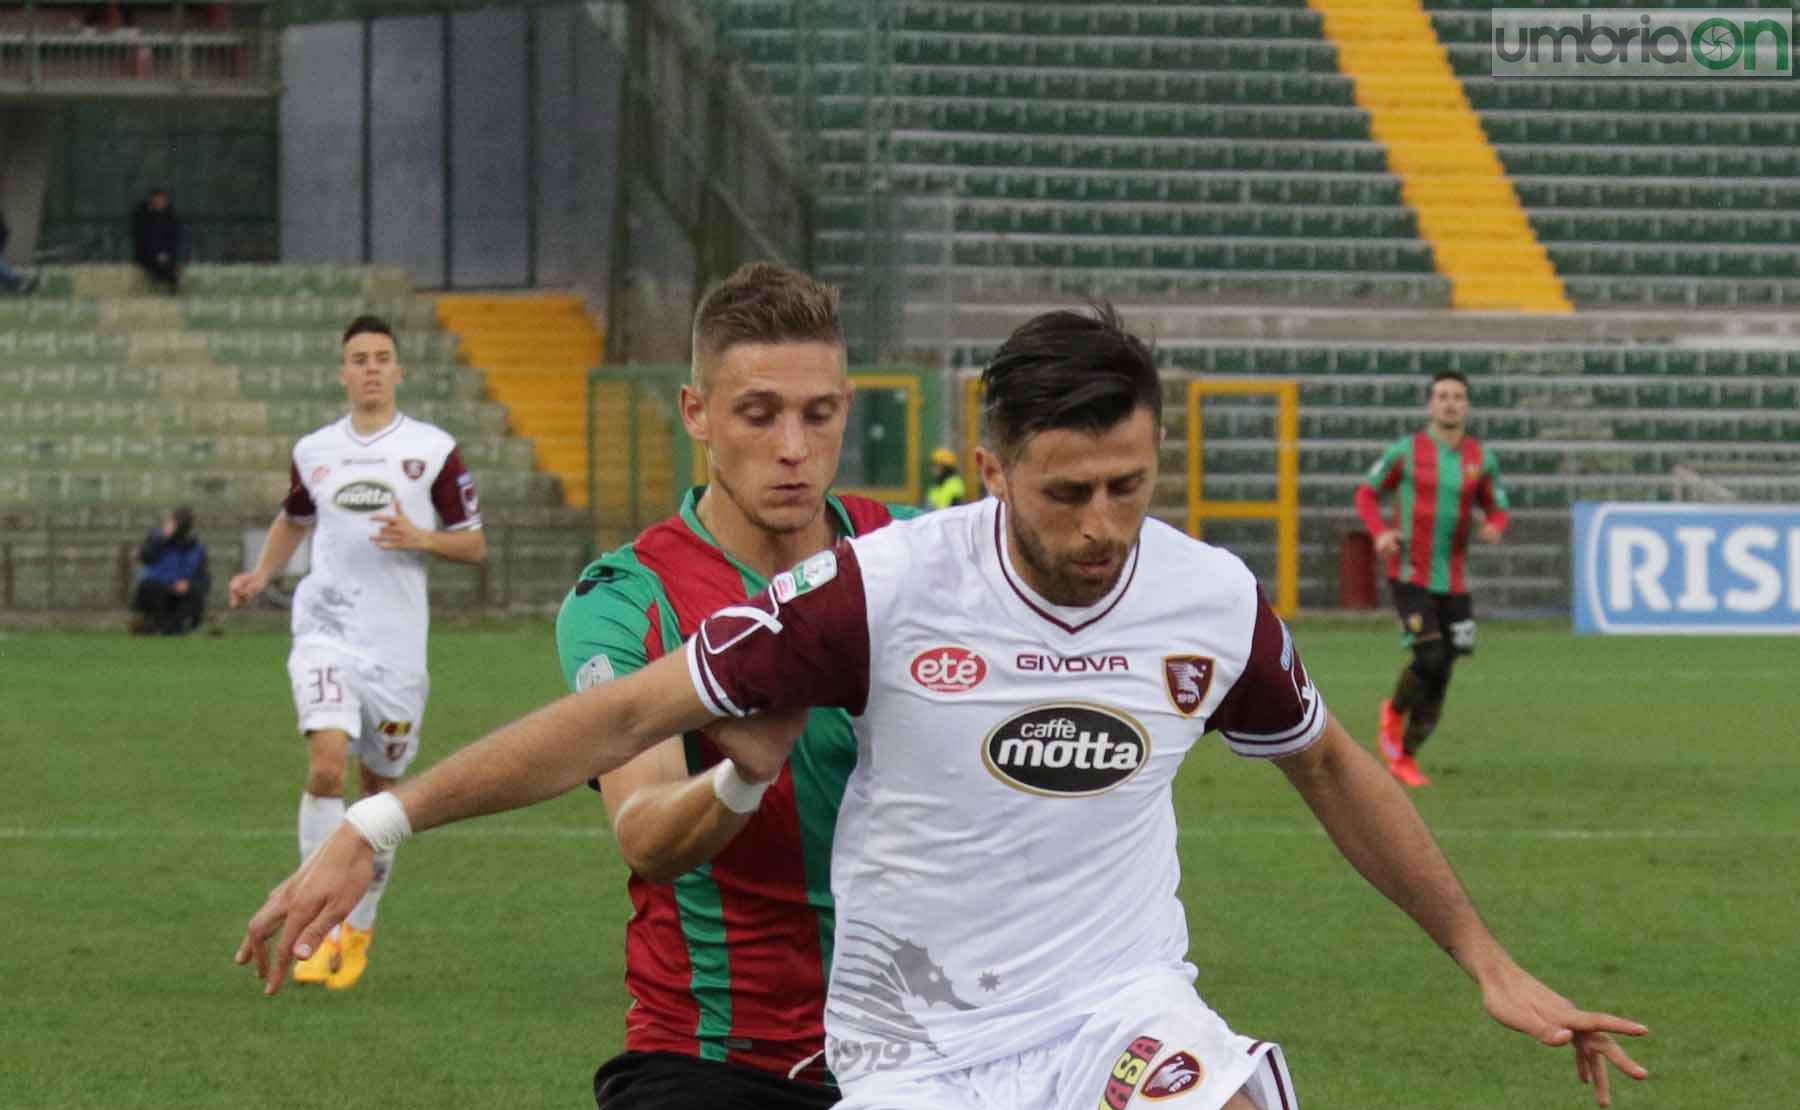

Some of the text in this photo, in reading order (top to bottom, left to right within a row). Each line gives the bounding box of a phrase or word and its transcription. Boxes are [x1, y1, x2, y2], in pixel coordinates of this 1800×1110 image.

[1016, 654, 1129, 672] GIVOVA
[308, 666, 342, 704] 35
[1020, 719, 1077, 739] caffè
[1000, 732, 1138, 770] motta
